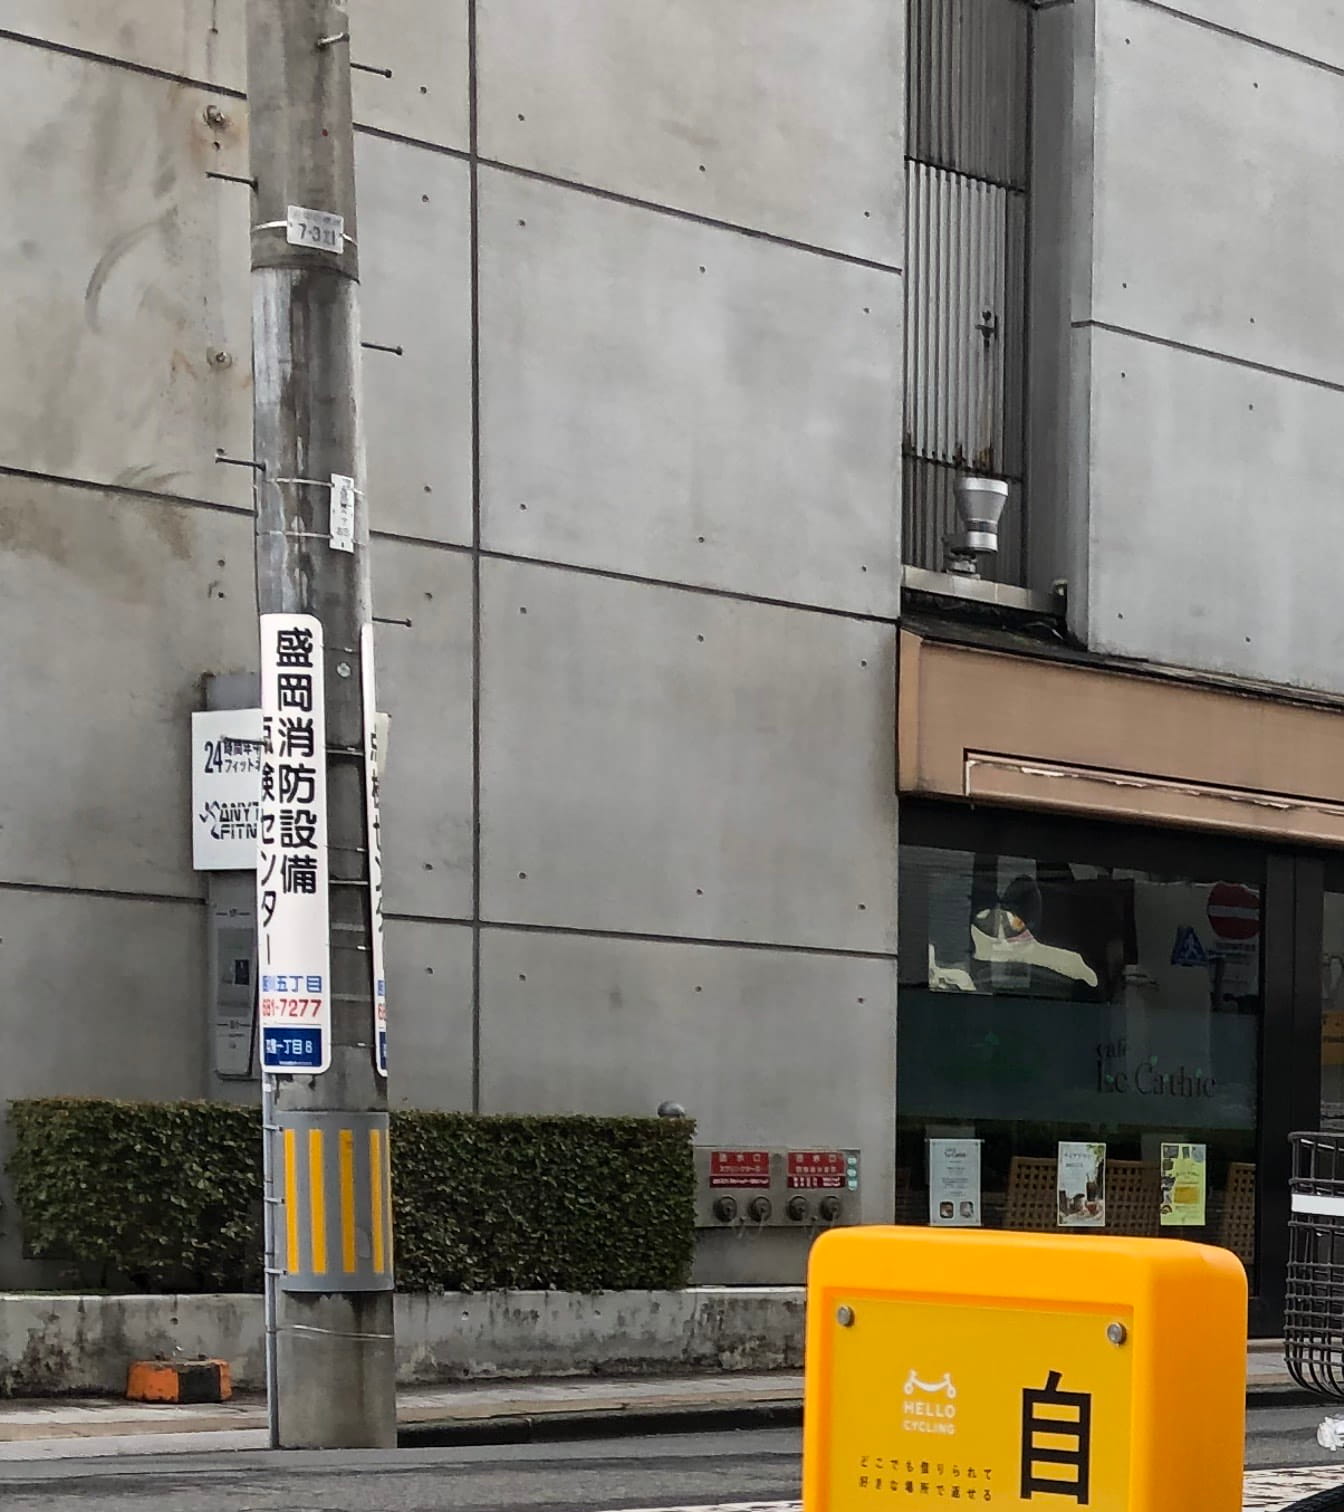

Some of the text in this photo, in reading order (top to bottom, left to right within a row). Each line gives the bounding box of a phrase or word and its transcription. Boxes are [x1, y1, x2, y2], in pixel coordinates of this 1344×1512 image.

[276, 627, 318, 895] 盛岡消防設備
[903, 1400, 956, 1420] HELLO
[903, 1419, 956, 1436] CYCLING
[860, 1455, 993, 1481] どこでも借りられて
